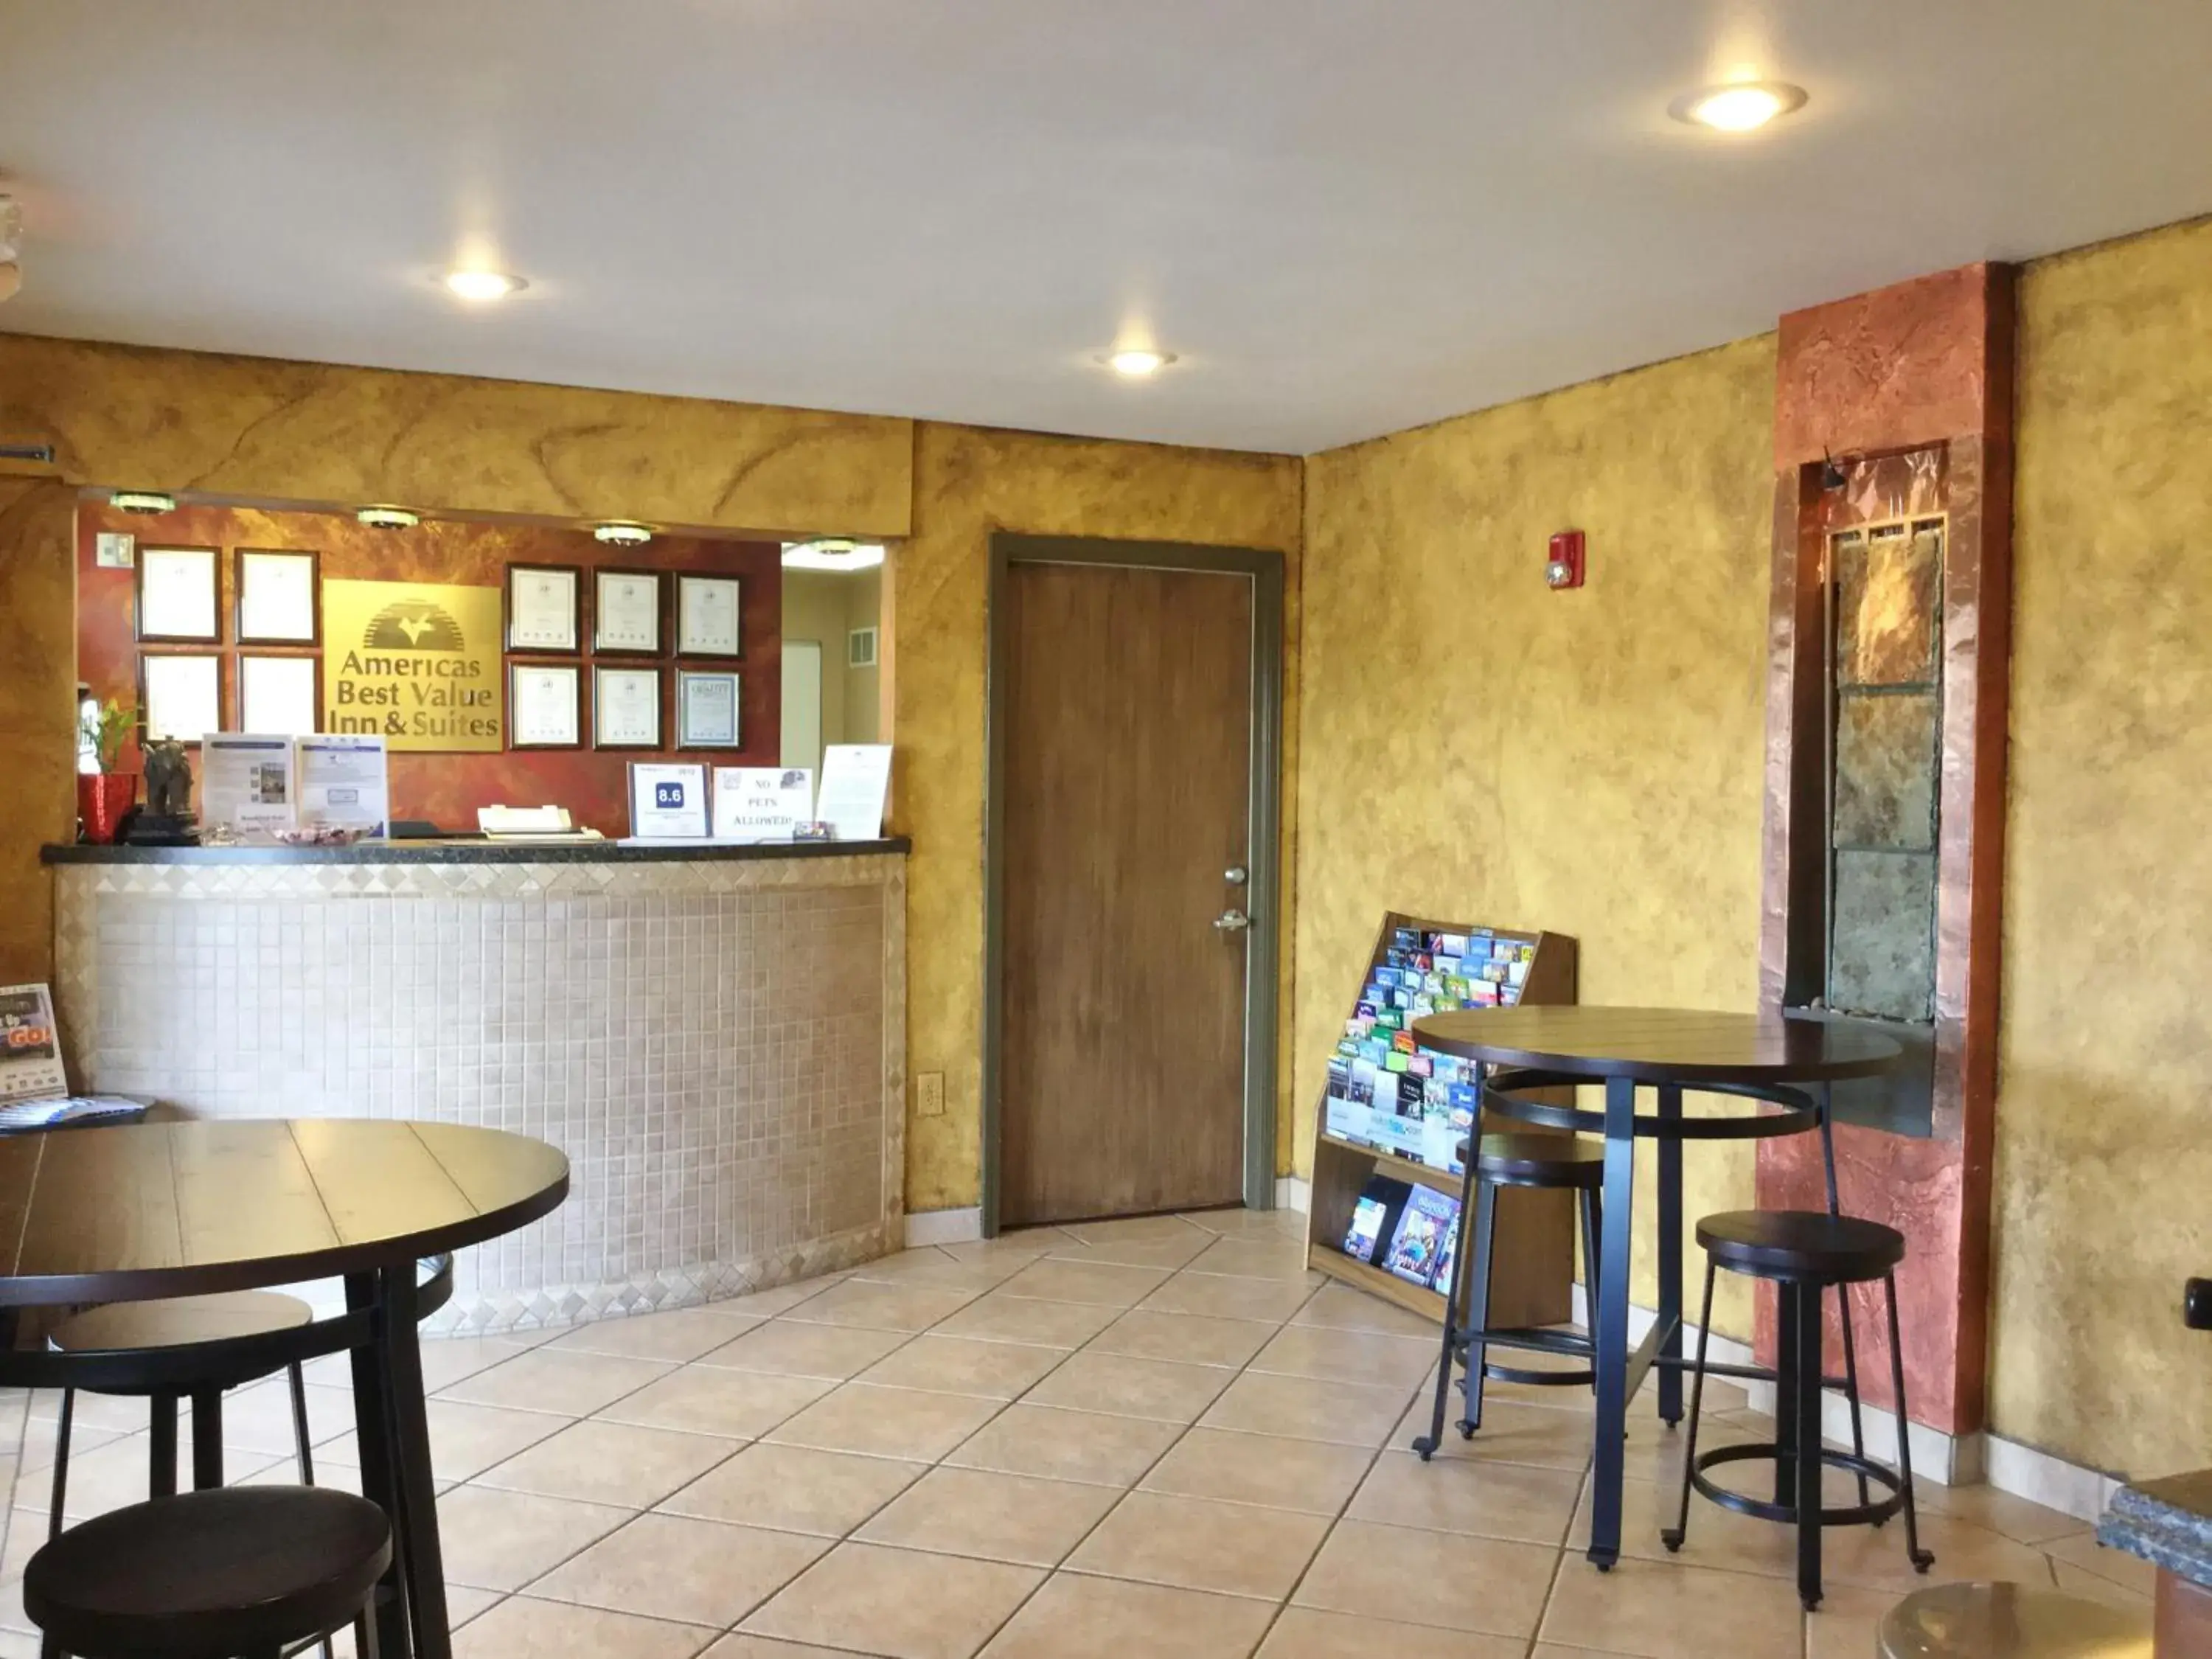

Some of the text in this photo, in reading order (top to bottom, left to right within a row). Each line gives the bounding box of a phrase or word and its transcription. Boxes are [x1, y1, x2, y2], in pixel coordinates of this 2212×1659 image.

[340, 650, 481, 678] Americas
[338, 680, 493, 708] Best Value
[330, 709, 498, 737] Inn & Suites
[756, 779, 771, 789] NO
[658, 789, 681, 802] 8.6
[748, 797, 777, 807] PETS
